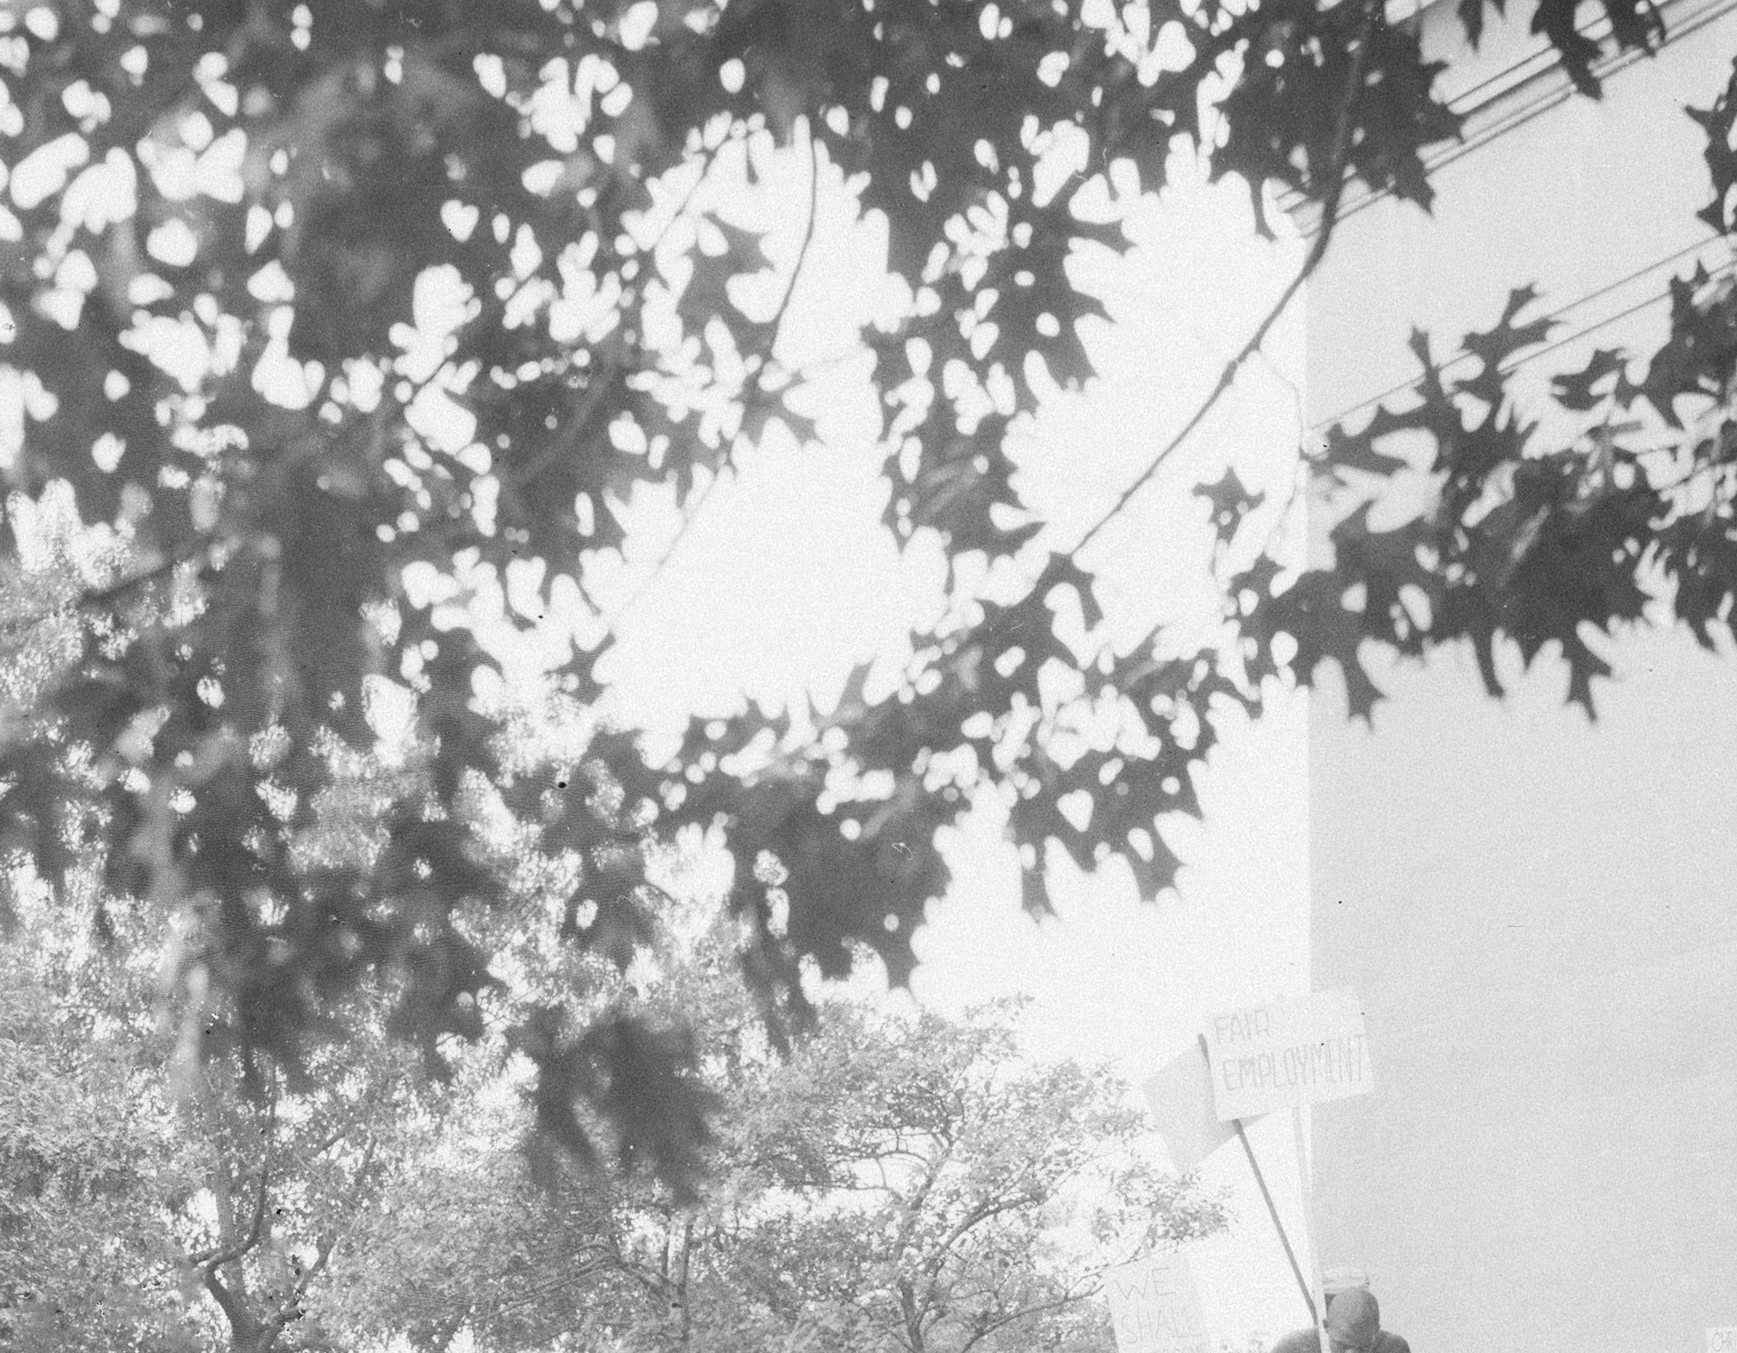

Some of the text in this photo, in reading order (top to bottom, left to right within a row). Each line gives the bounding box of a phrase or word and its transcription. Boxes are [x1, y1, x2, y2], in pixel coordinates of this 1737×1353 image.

[1215, 1008, 1271, 1045] FAIR
[1223, 1034, 1367, 1091] EMPLOYMENT
[1115, 1267, 1176, 1300] WE
[1121, 1305, 1203, 1344] SHALL
